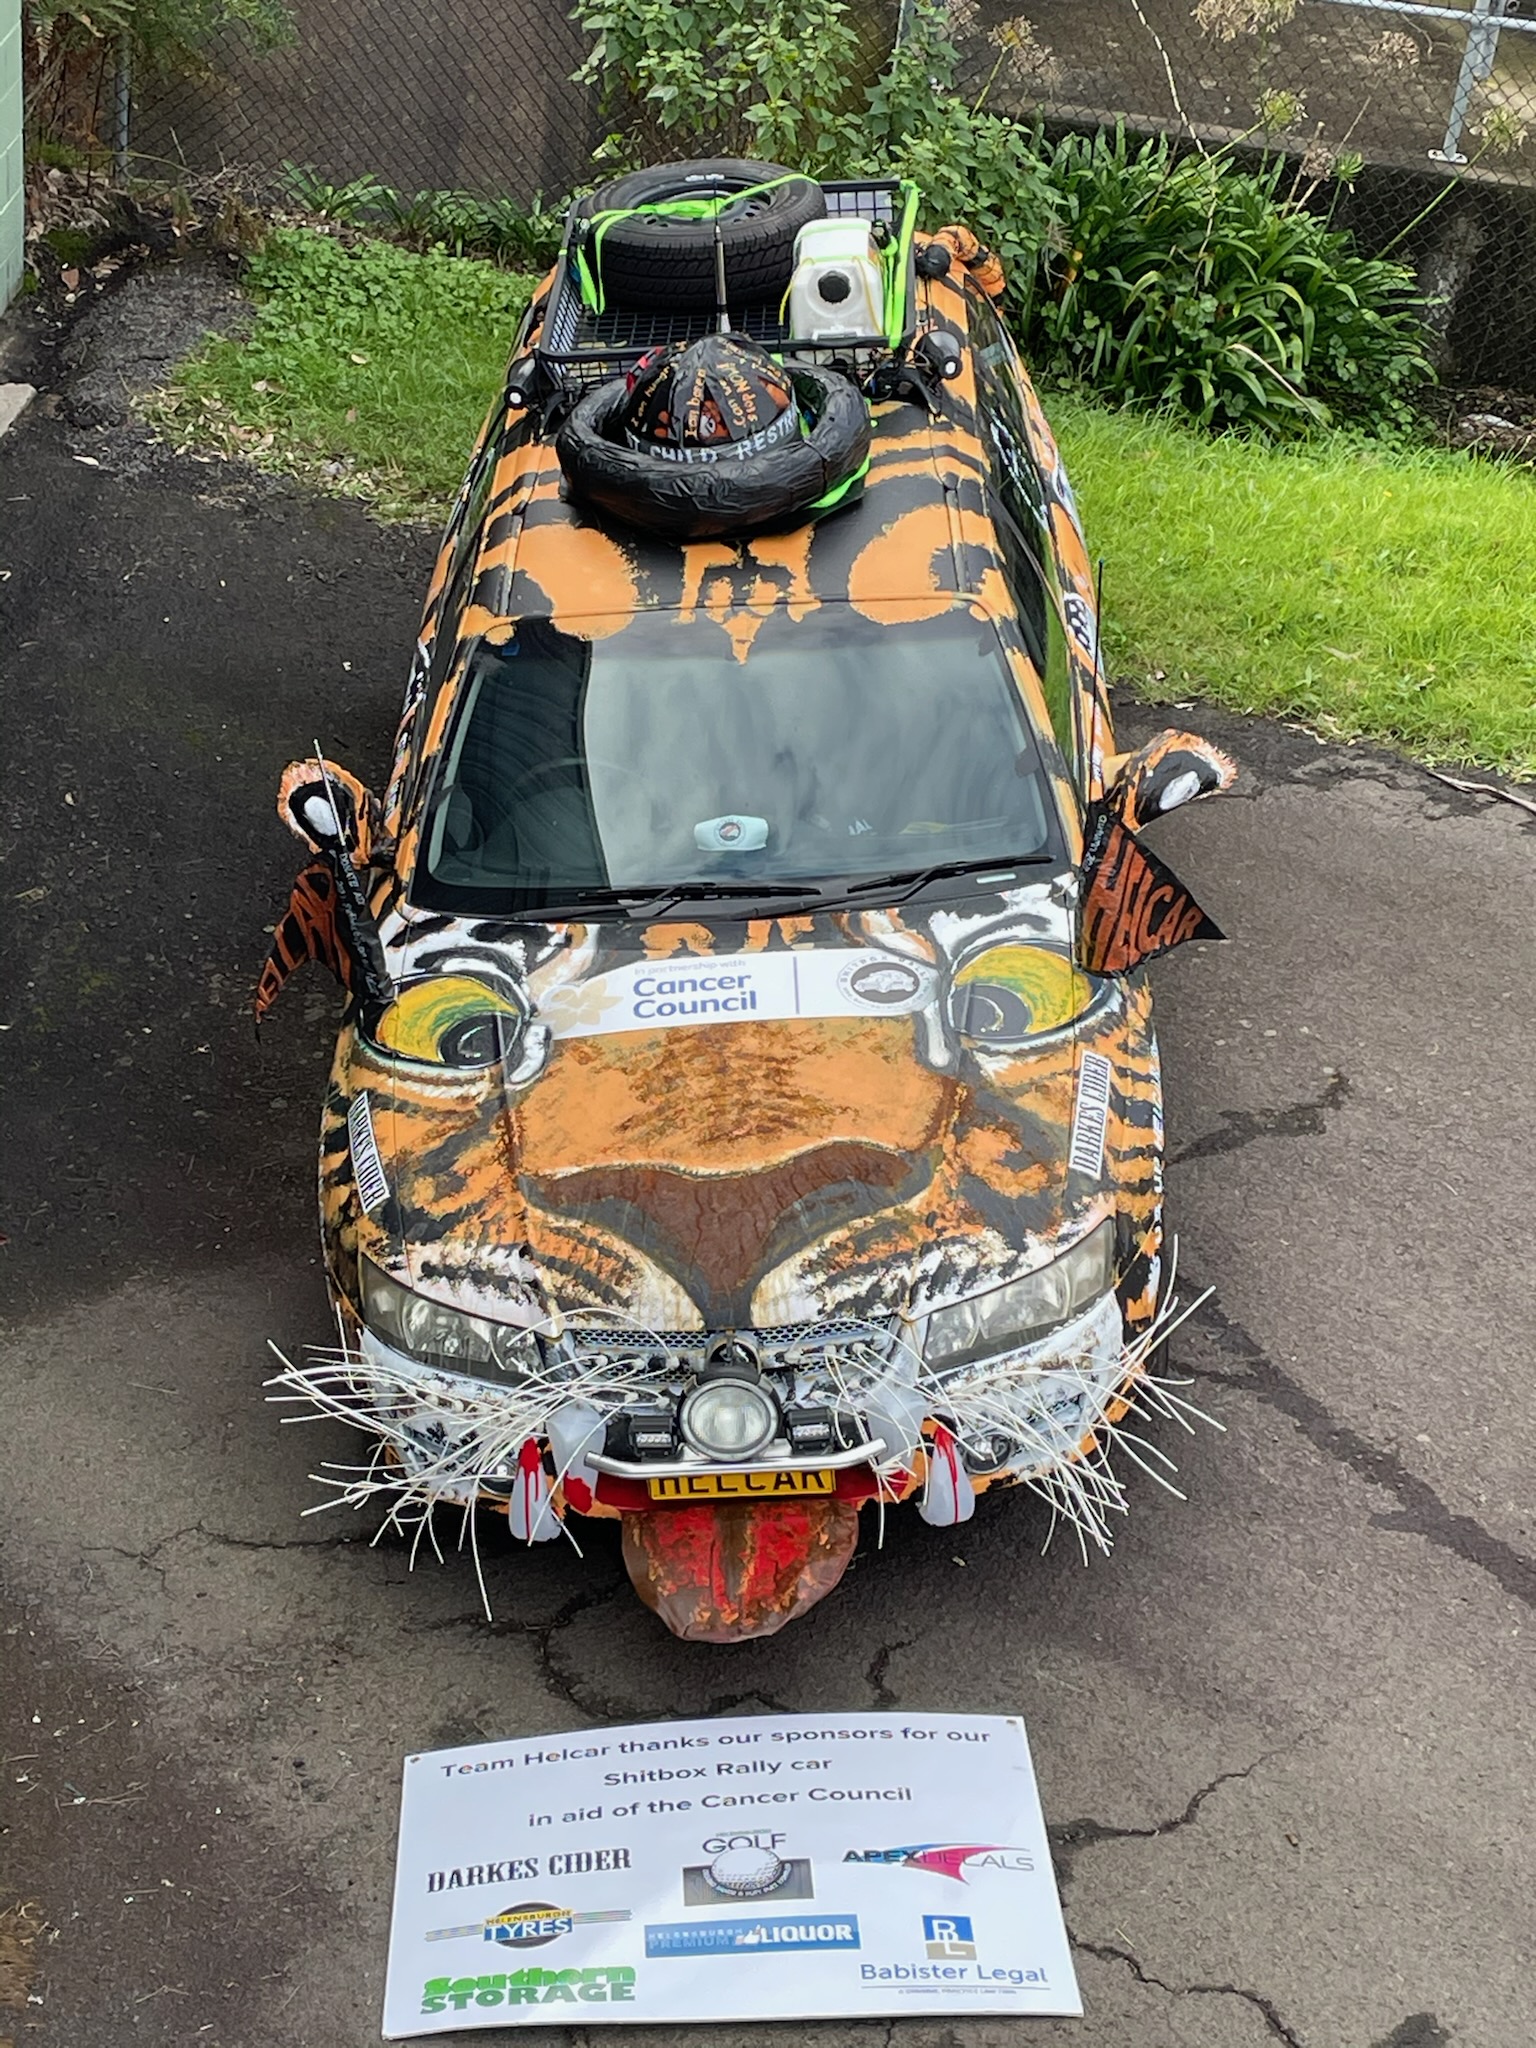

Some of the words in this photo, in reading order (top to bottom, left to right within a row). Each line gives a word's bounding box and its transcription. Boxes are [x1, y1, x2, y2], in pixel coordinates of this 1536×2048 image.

[647, 961, 718, 976] partnership
[633, 974, 752, 997] Cancer
[633, 990, 757, 1019] Council
[1081, 1054, 1109, 1103] CIDER
[1072, 1102, 1106, 1174] DARKES
[440, 1757, 514, 1778] Team
[524, 1746, 611, 1766] Helcar
[619, 1735, 709, 1755] thanks
[718, 1731, 762, 1746] our
[771, 1728, 893, 1744] sponsors
[901, 1727, 938, 1740] for
[947, 1730, 991, 1743] our
[604, 1765, 707, 1787] Shitbox
[716, 1758, 782, 1775] Rally
[791, 1758, 833, 1772] car
[529, 1813, 552, 1827] in
[562, 1806, 602, 1824] aid
[612, 1801, 642, 1818] of
[647, 1798, 692, 1815] the
[701, 1791, 800, 1809] Cancer
[808, 1787, 913, 1802] Council
[702, 1832, 787, 1854] GOLF
[427, 1857, 540, 1894] DARKES
[549, 1848, 632, 1877] CIDER
[485, 1917, 570, 1941] TYRES
[649, 1936, 730, 1950] PREMIUM
[761, 1924, 854, 1944] LIQUOR
[423, 1966, 636, 1998] Southern
[860, 1963, 968, 1980] Babister
[977, 1964, 1049, 1985] Legal
[420, 1982, 636, 2014] STORAGE
